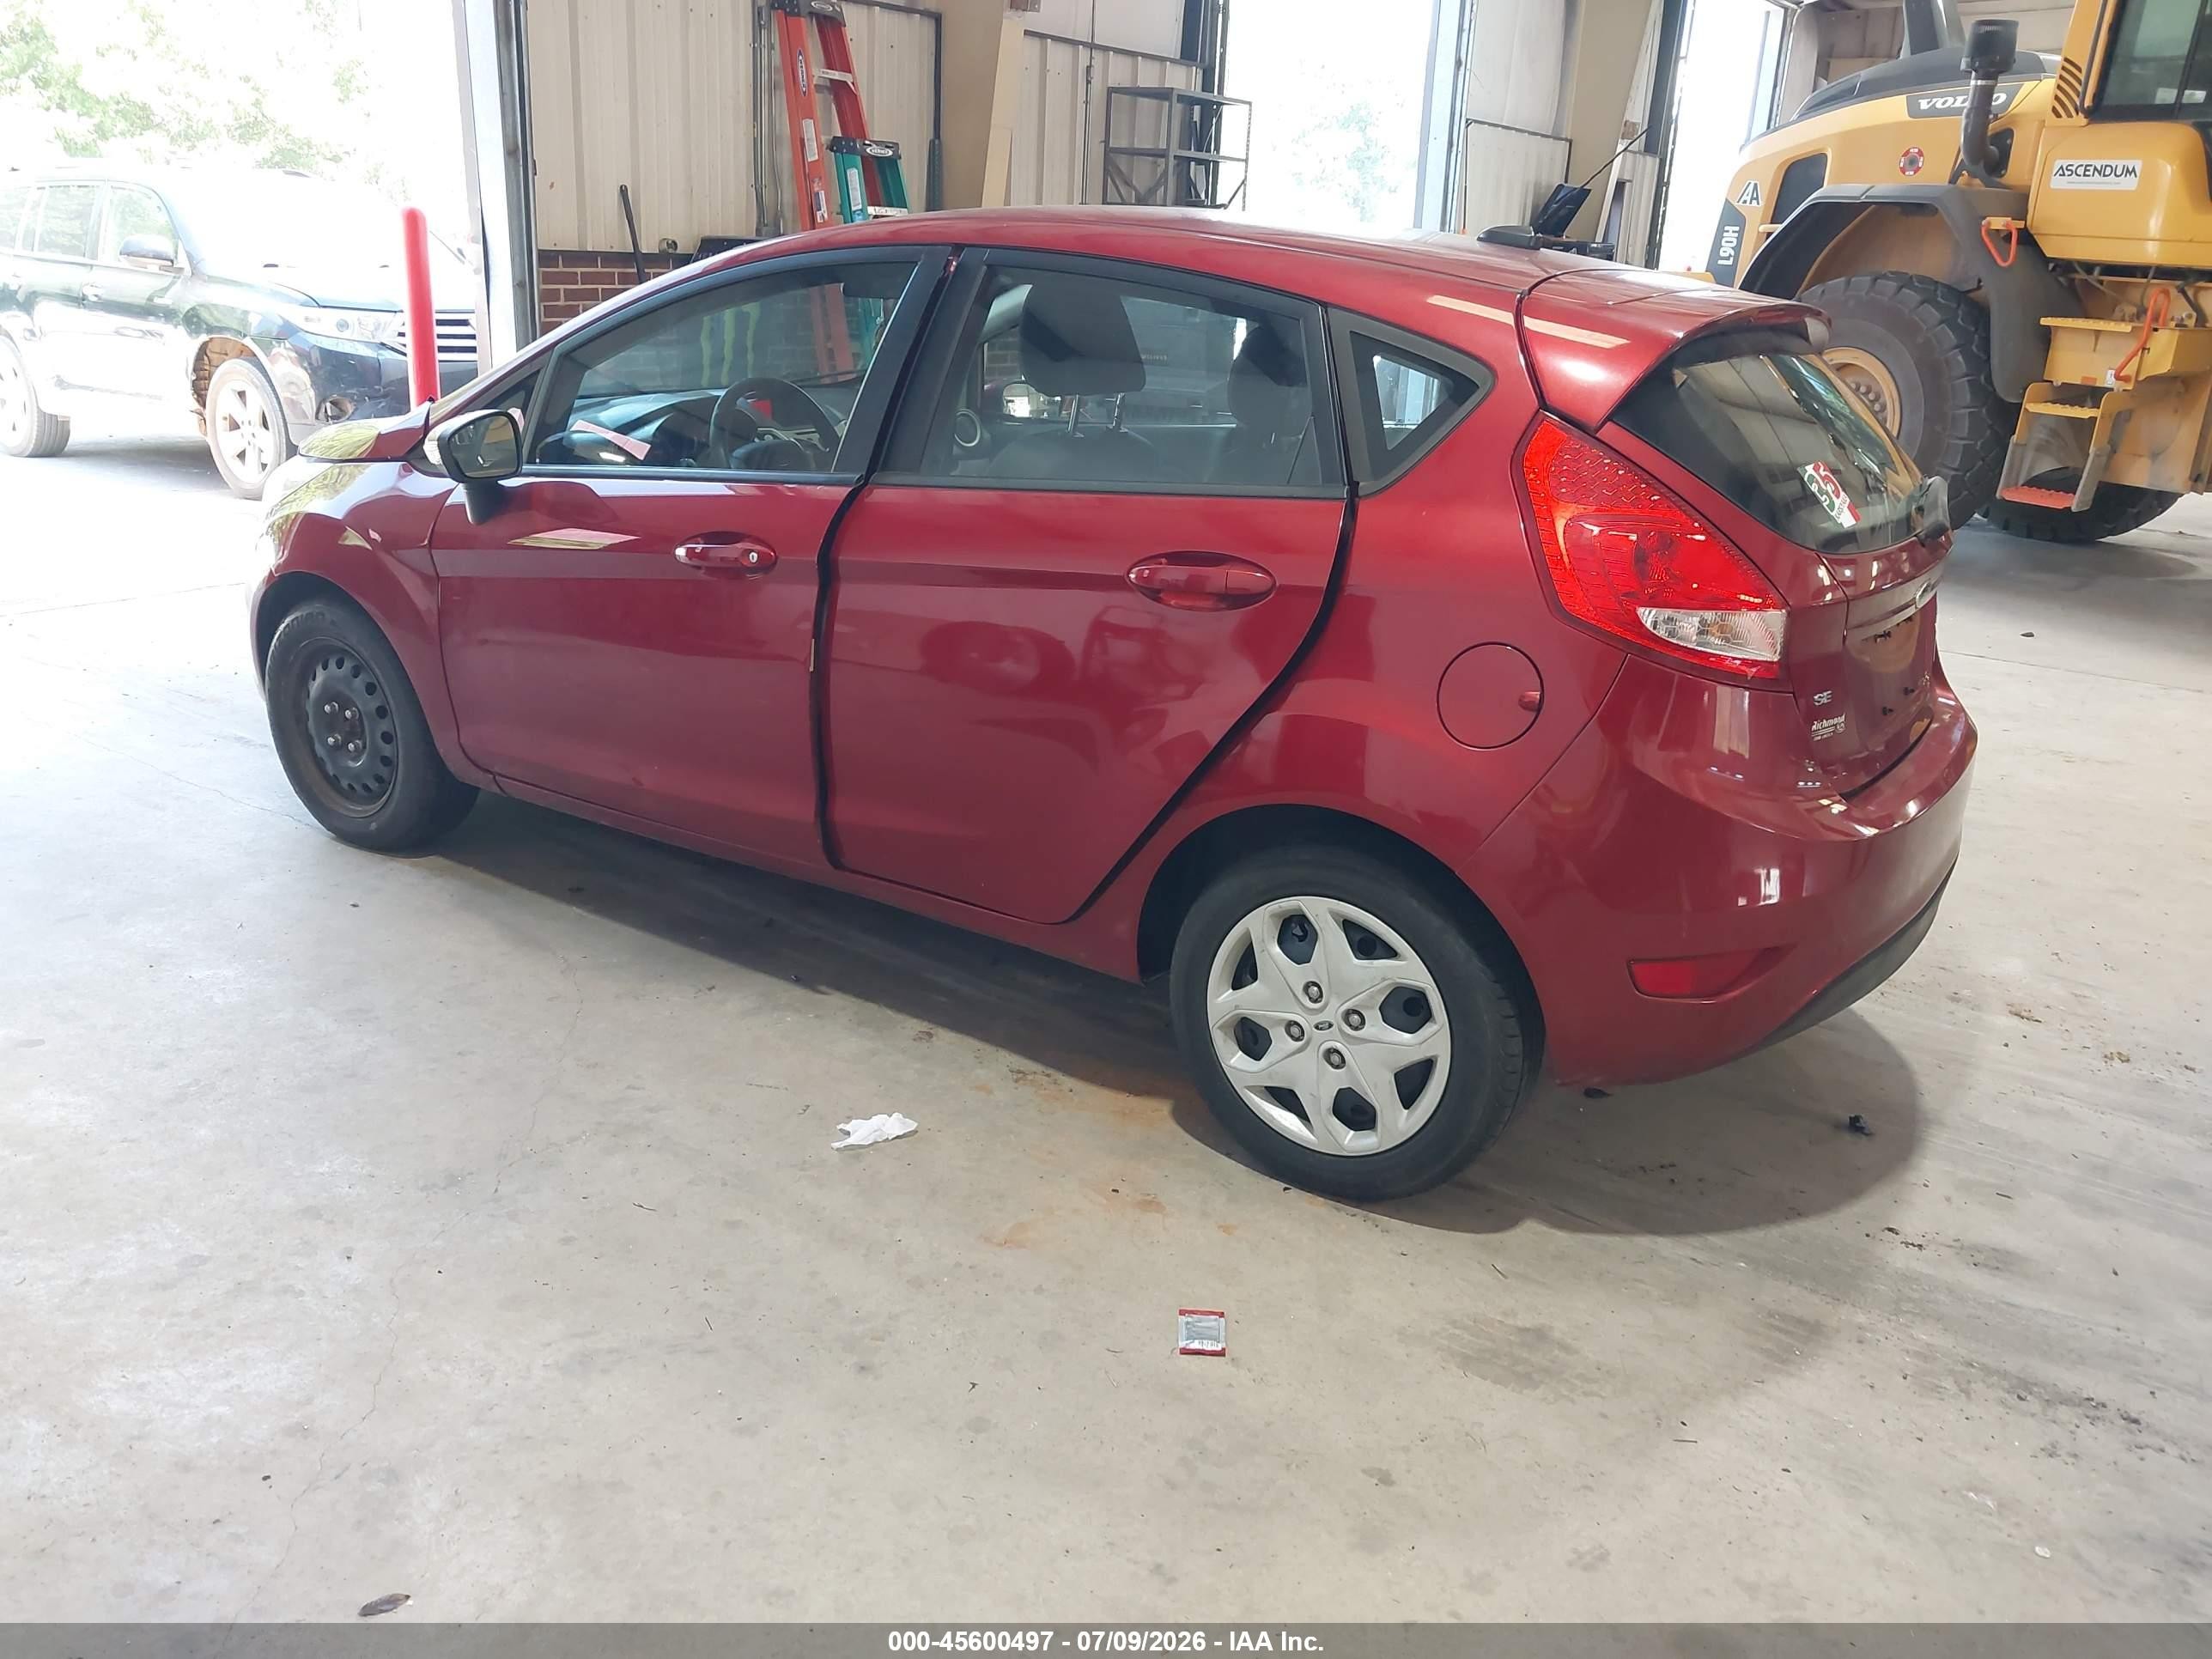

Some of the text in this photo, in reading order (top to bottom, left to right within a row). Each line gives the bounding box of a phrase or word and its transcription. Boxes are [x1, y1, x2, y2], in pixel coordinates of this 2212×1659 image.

[1918, 93, 2008, 110] VOLO
[2053, 164, 2138, 178] ASCENDUM
[1717, 226, 1740, 265] L90H
[1813, 690, 1832, 705] SE
[1811, 713, 1846, 732] Richmond
